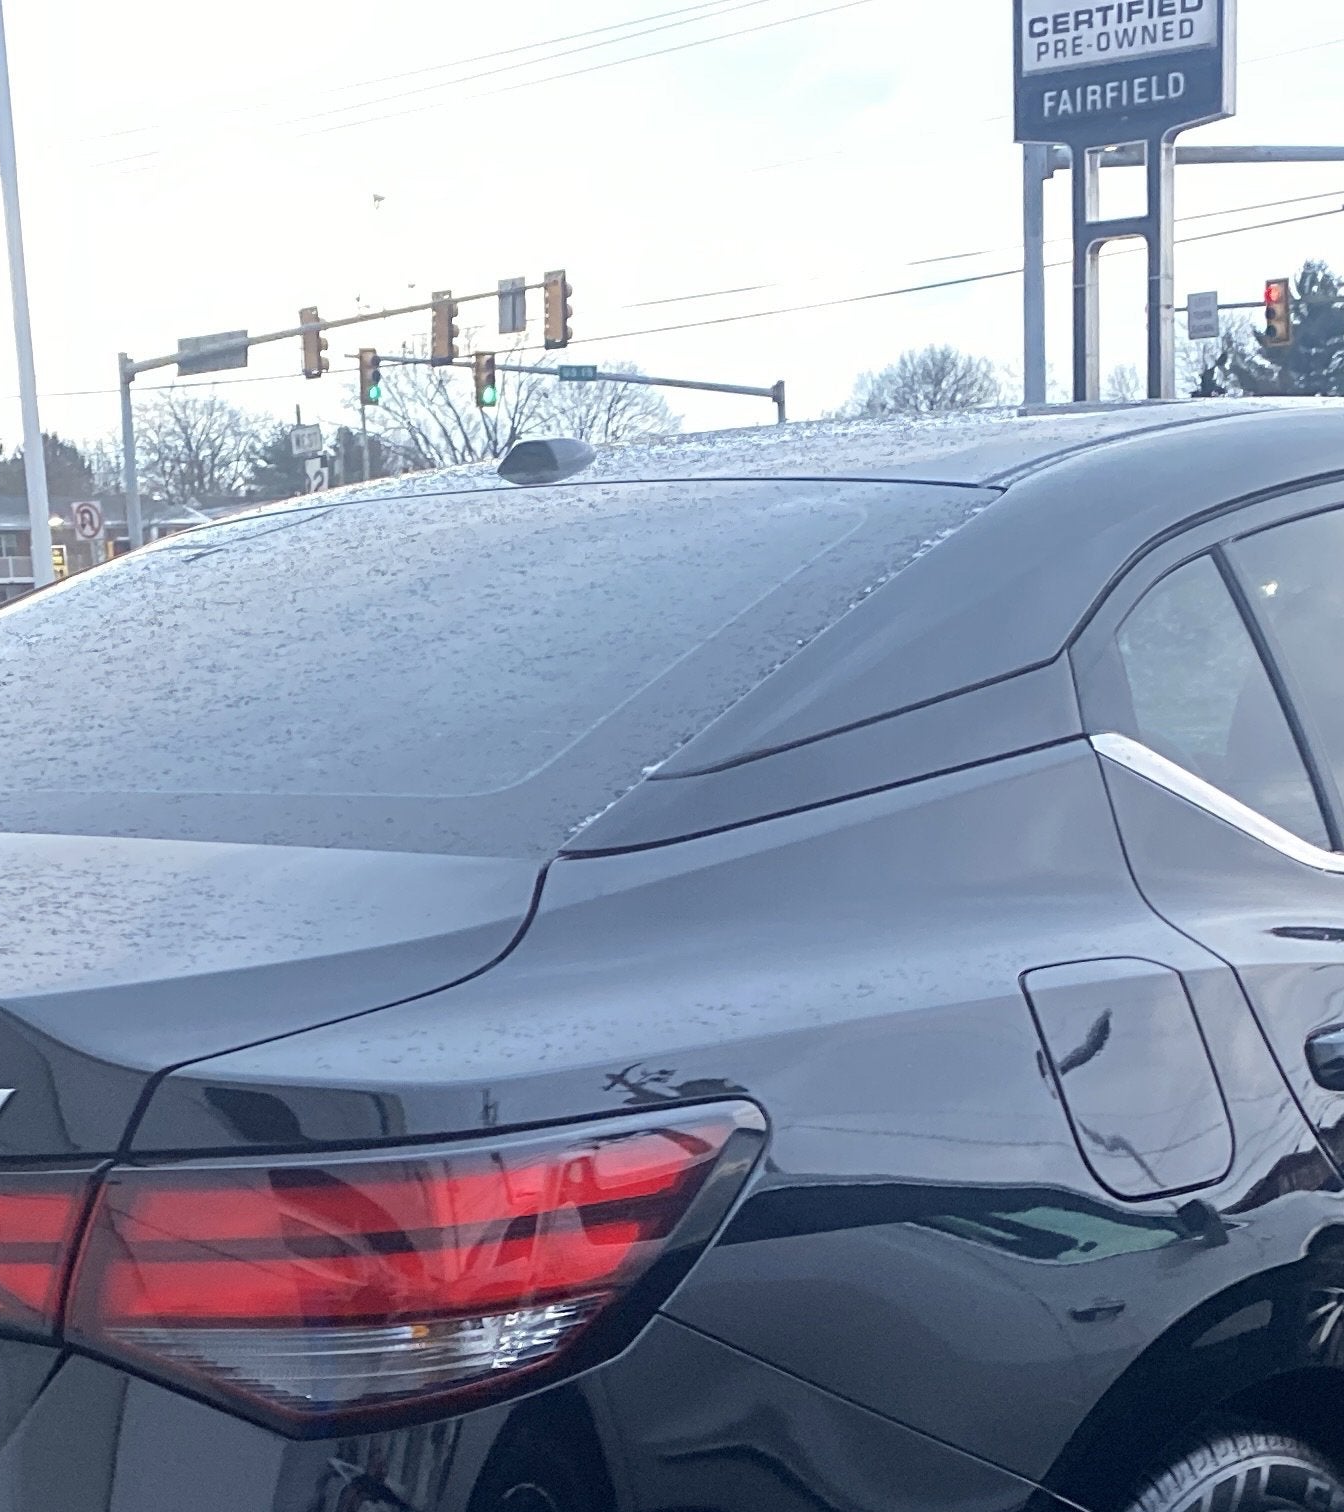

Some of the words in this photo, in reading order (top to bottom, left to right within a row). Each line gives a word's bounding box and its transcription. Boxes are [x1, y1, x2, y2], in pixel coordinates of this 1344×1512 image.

[1028, 0, 1204, 39] CERTIFIED
[1036, 18, 1195, 62] PRE-OWNED
[1043, 71, 1186, 118] FAIRFIELD
